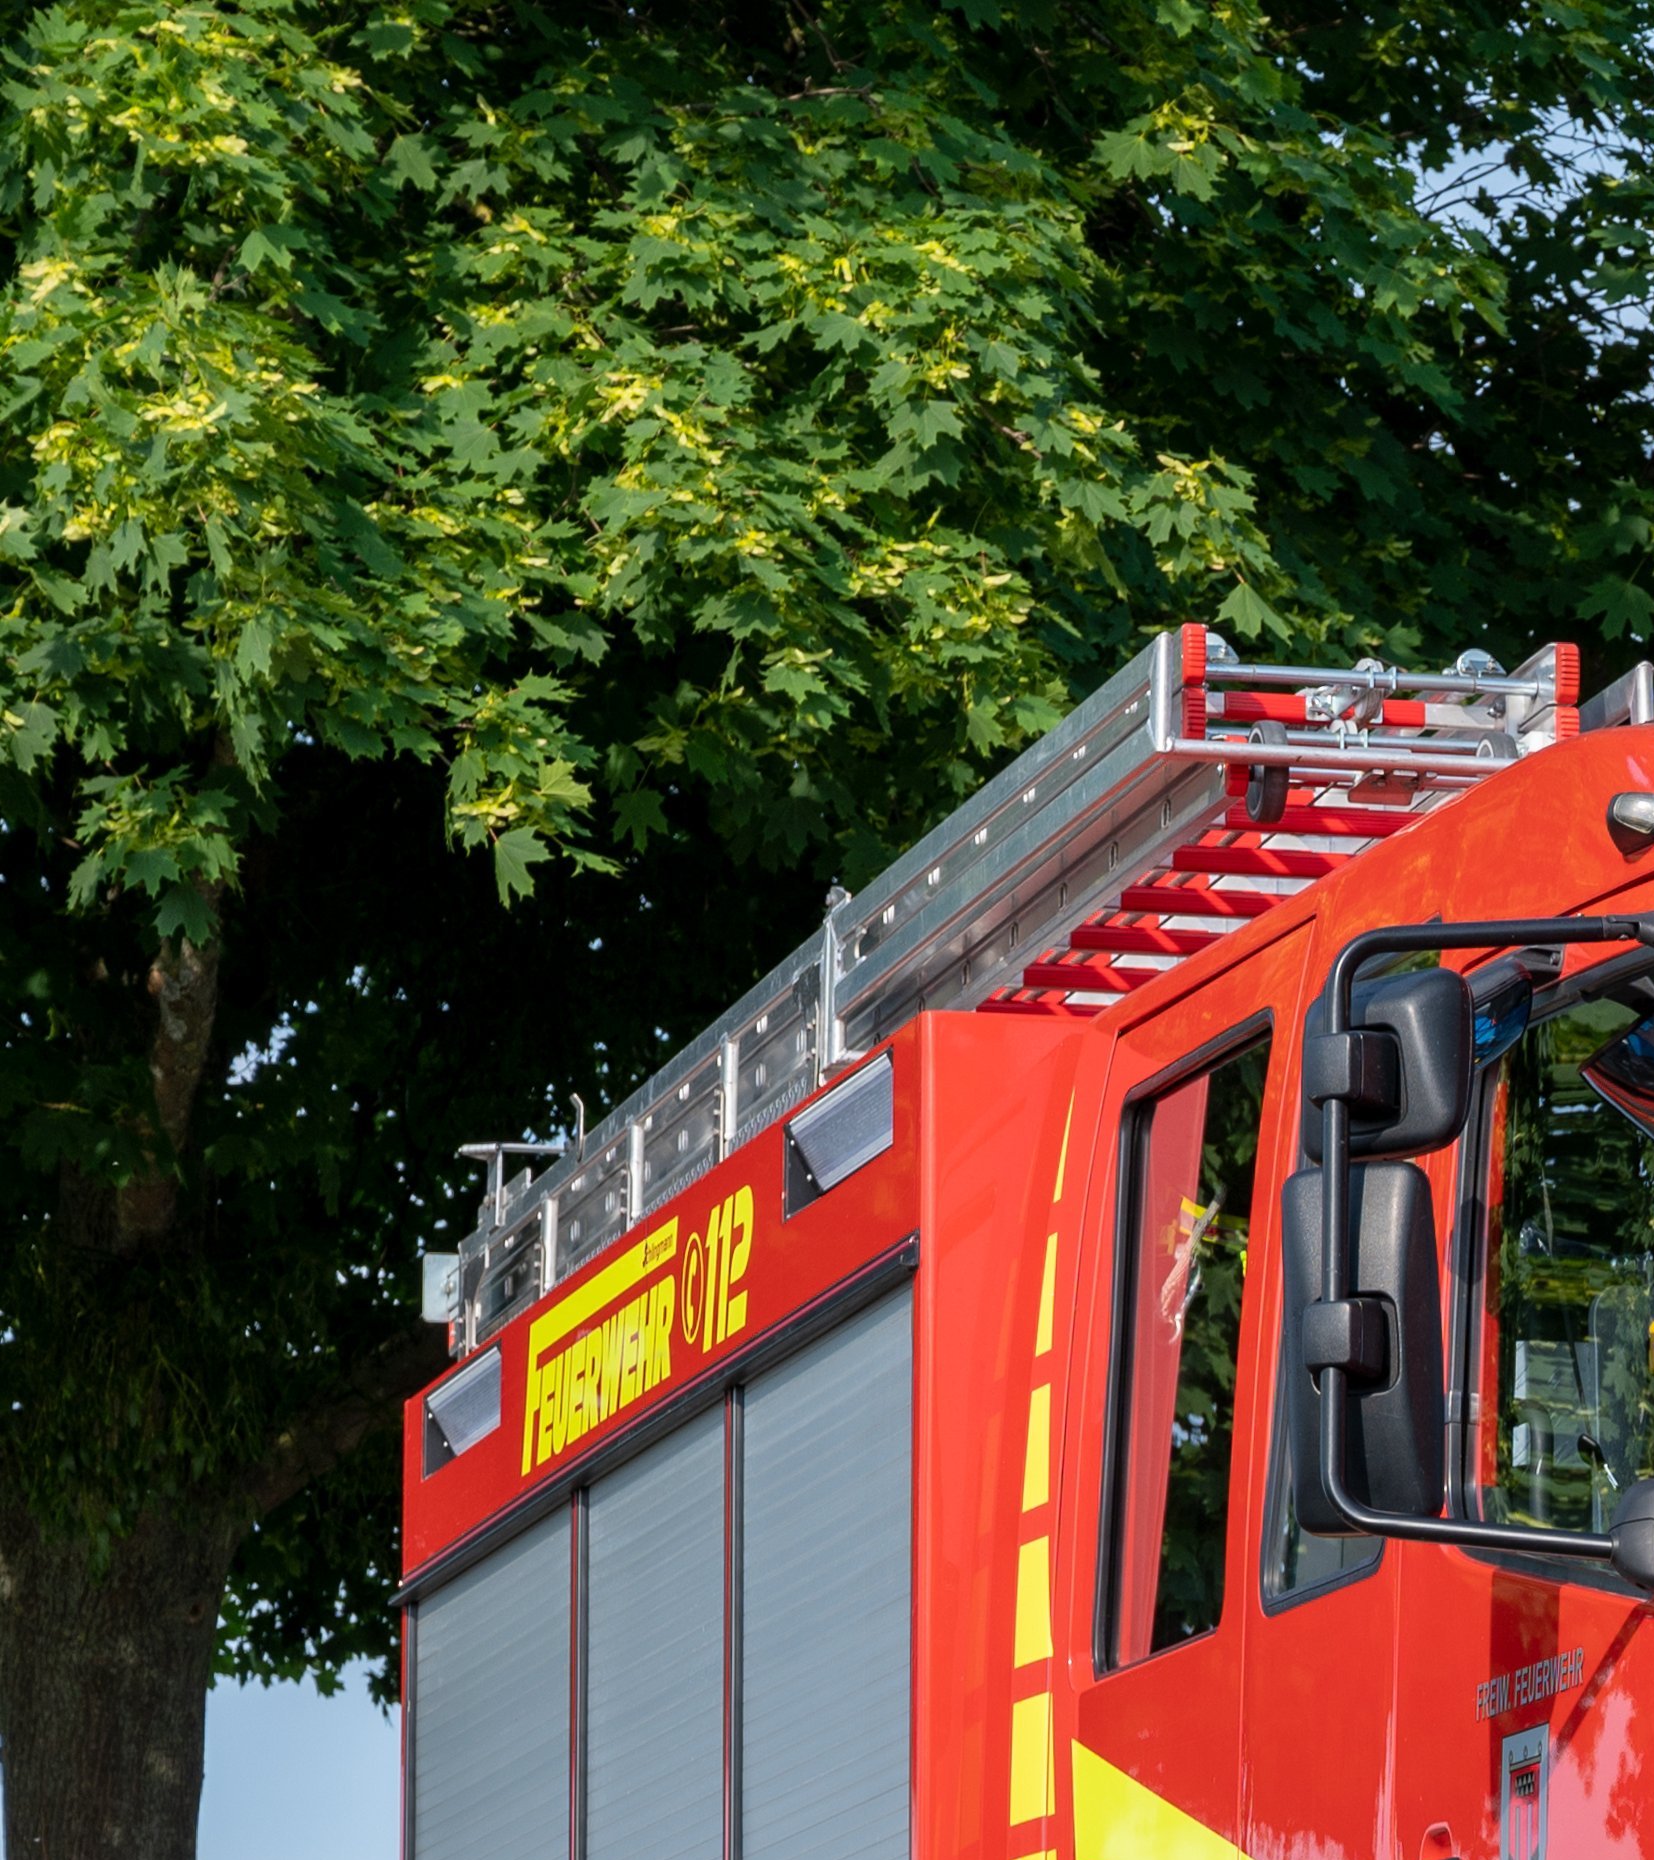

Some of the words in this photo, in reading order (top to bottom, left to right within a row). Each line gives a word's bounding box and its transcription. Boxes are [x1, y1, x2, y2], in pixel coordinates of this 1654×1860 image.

[521, 1216, 679, 1478] FEUERWEHR
[703, 1185, 754, 1354] 112
[1476, 1673, 1511, 1721] FREIW.
[1514, 1647, 1584, 1708] FEUERWEHR
